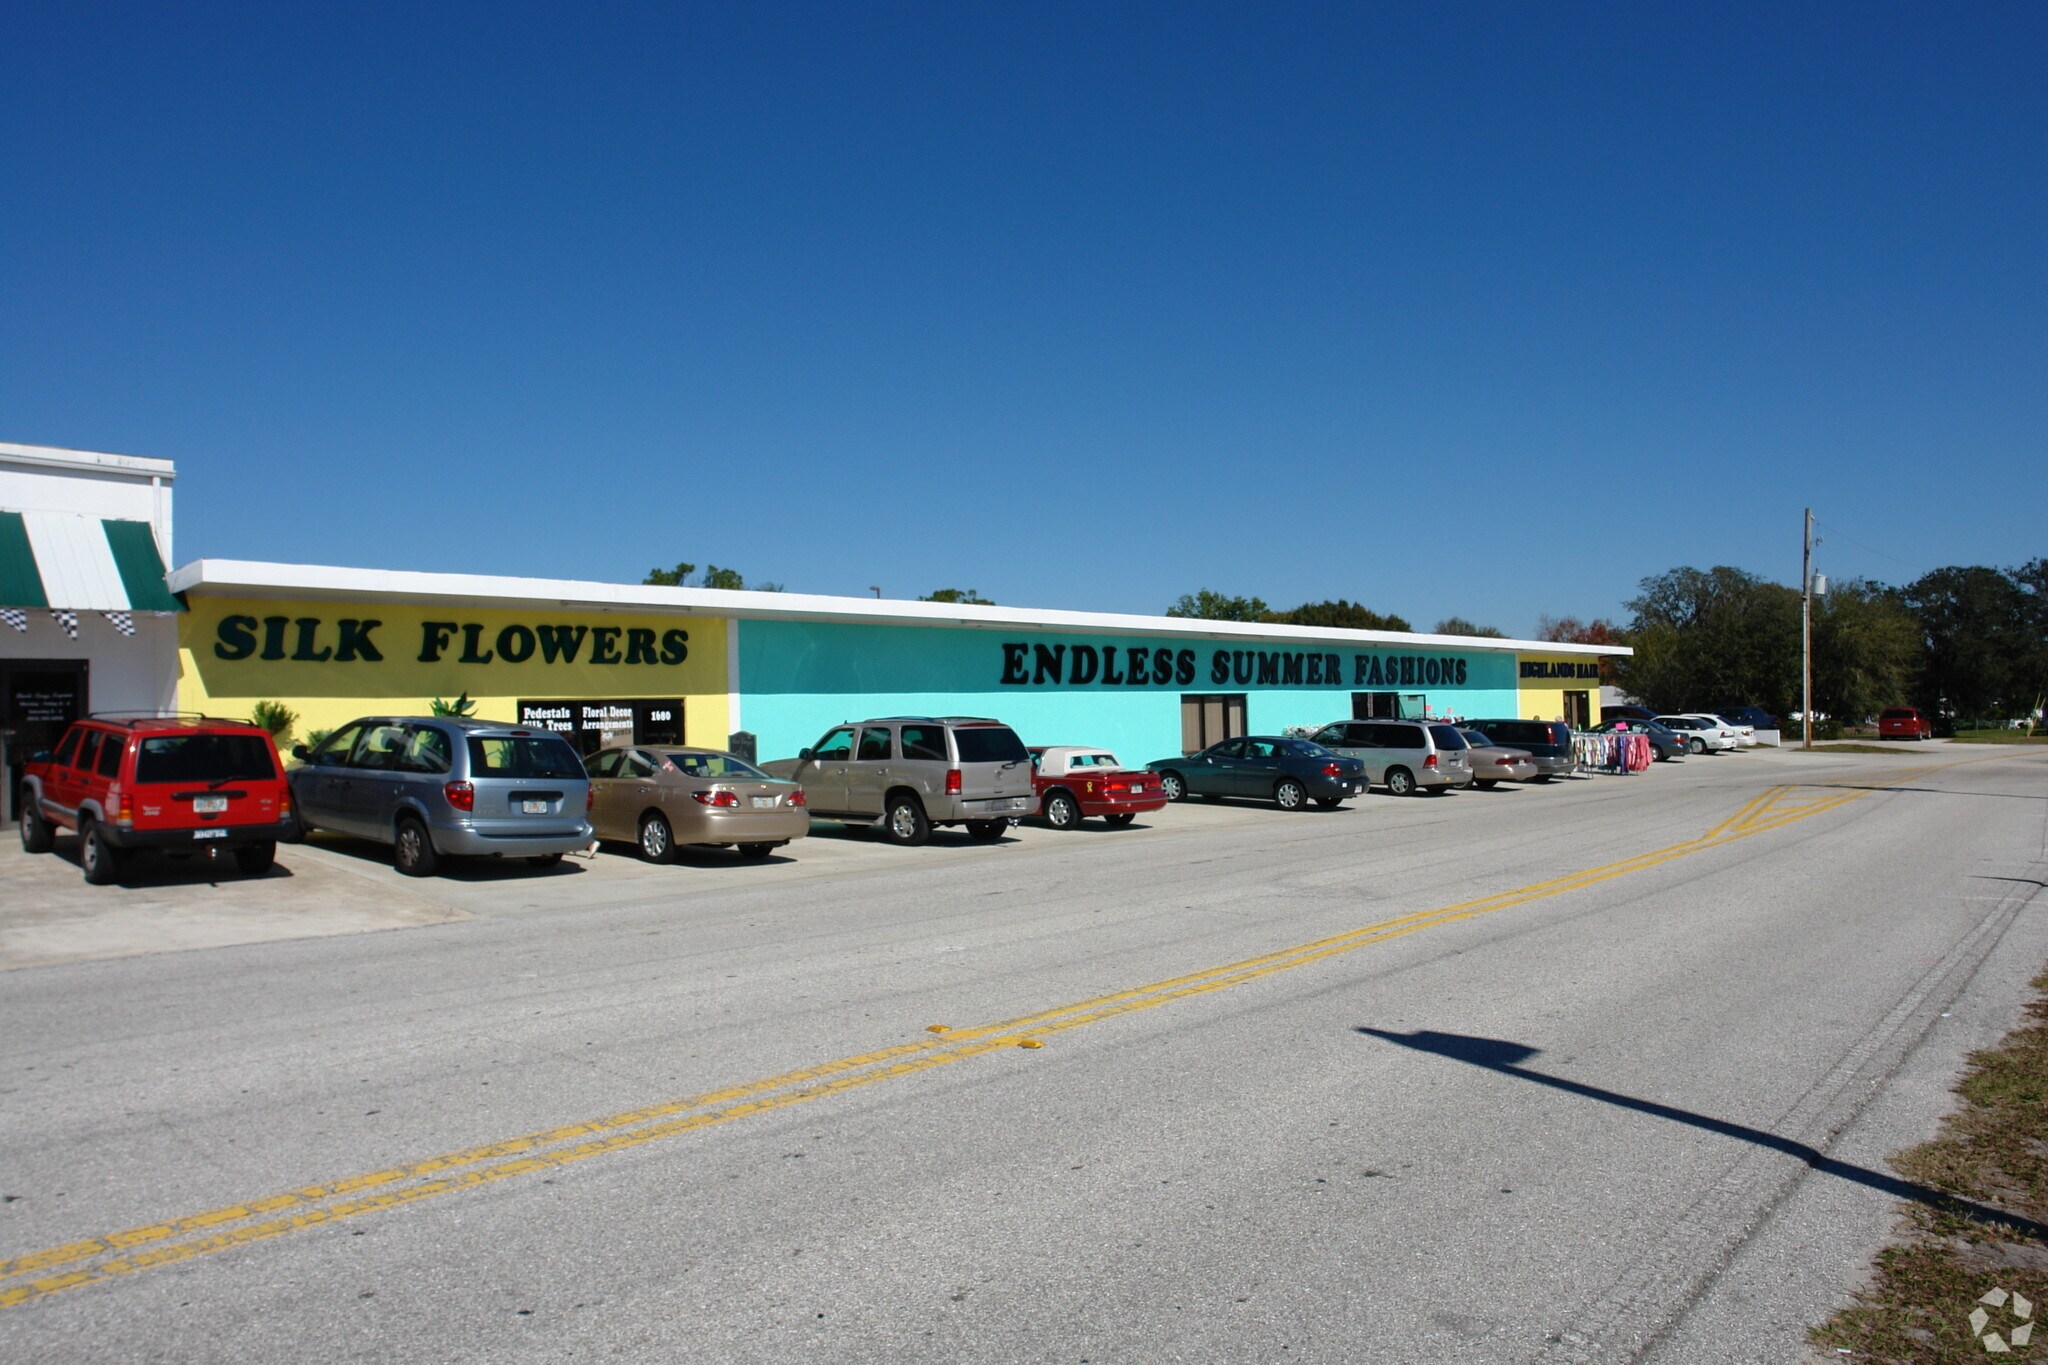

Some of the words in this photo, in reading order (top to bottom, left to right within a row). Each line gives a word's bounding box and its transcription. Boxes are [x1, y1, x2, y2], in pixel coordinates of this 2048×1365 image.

[214, 615, 384, 662] SILK
[417, 621, 689, 665] FLOWERS
[1000, 643, 1196, 685] ENDLESS
[1211, 650, 1342, 685] SUMMER
[1354, 655, 1467, 685] FASHIONS
[1520, 662, 1575, 678] HIGHLANDS
[523, 707, 571, 719] Pedestals
[582, 706, 607, 718] Floral
[609, 706, 632, 717] Decor
[651, 710, 671, 721] 1680
[546, 719, 572, 731] Trees
[582, 719, 633, 730] Arrangements
